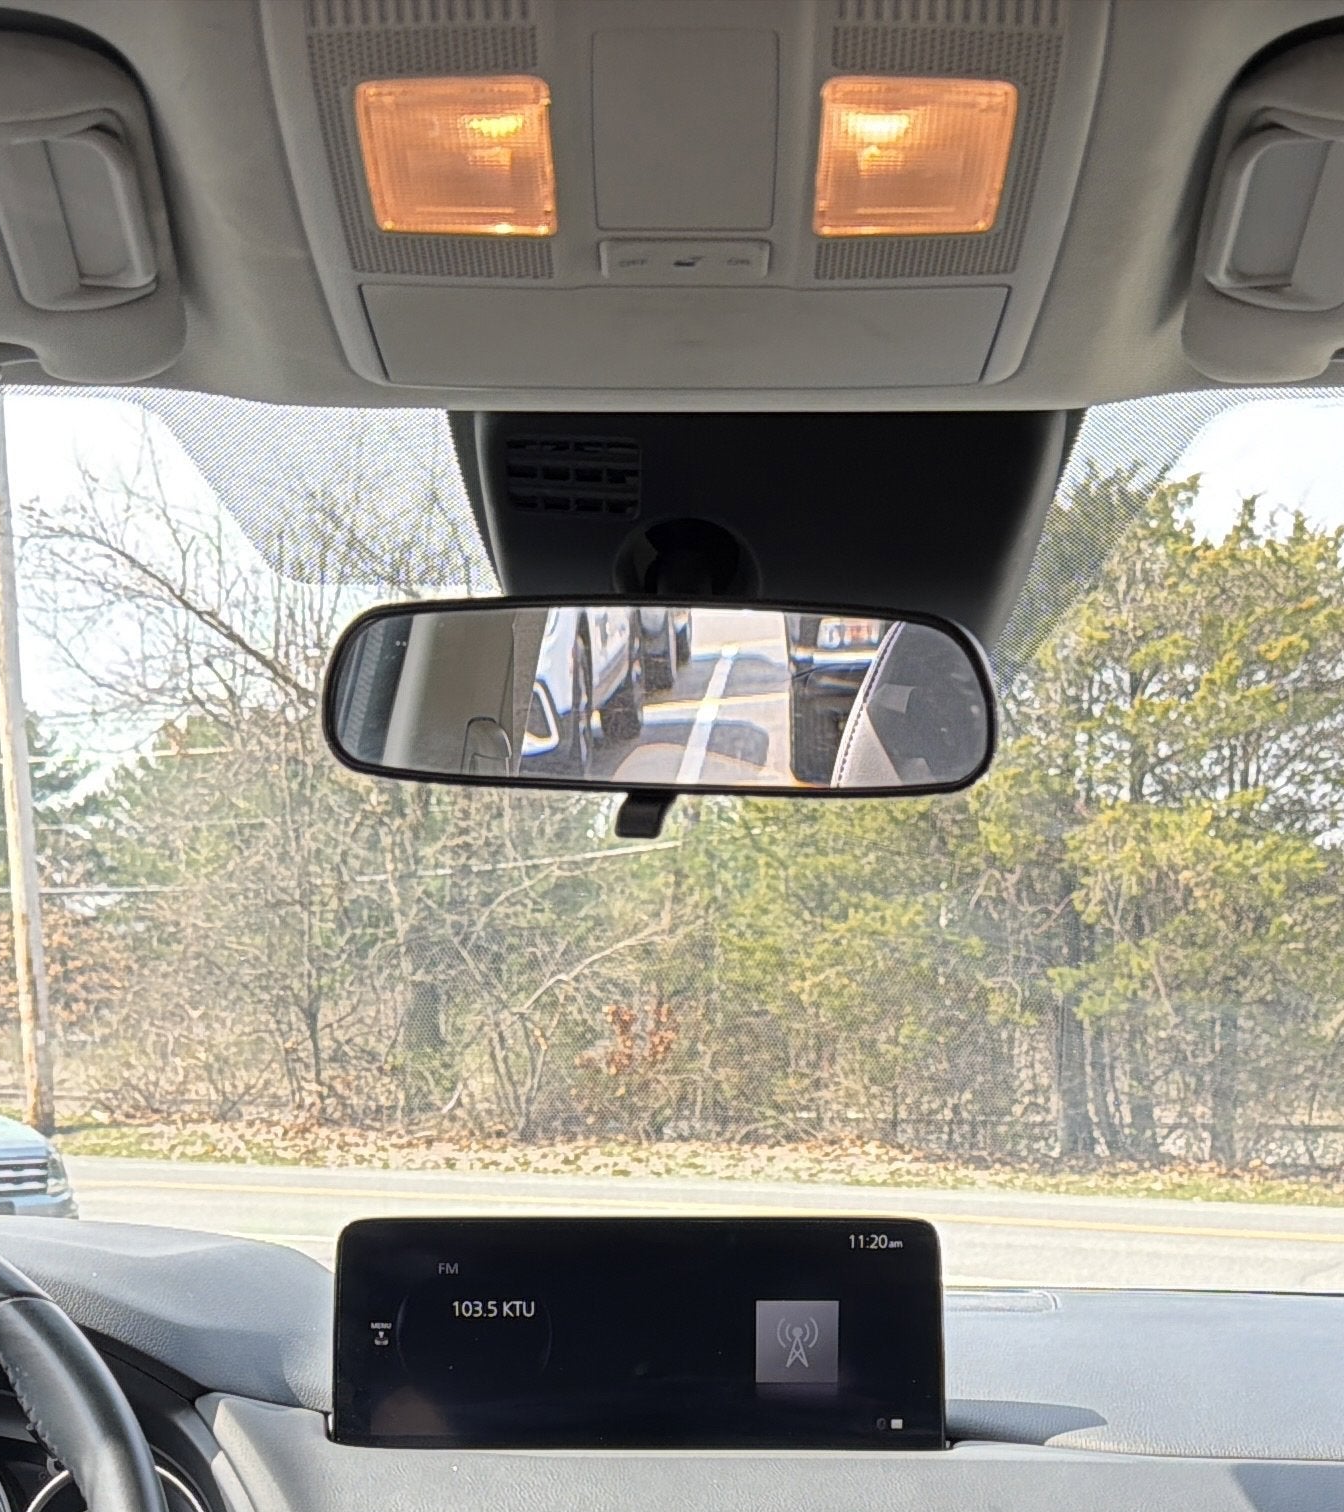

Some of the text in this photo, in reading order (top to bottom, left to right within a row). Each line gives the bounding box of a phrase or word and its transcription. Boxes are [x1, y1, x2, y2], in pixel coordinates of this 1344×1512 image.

[438, 1262, 459, 1275] FM
[452, 1300, 535, 1318] 103.5 KTU
